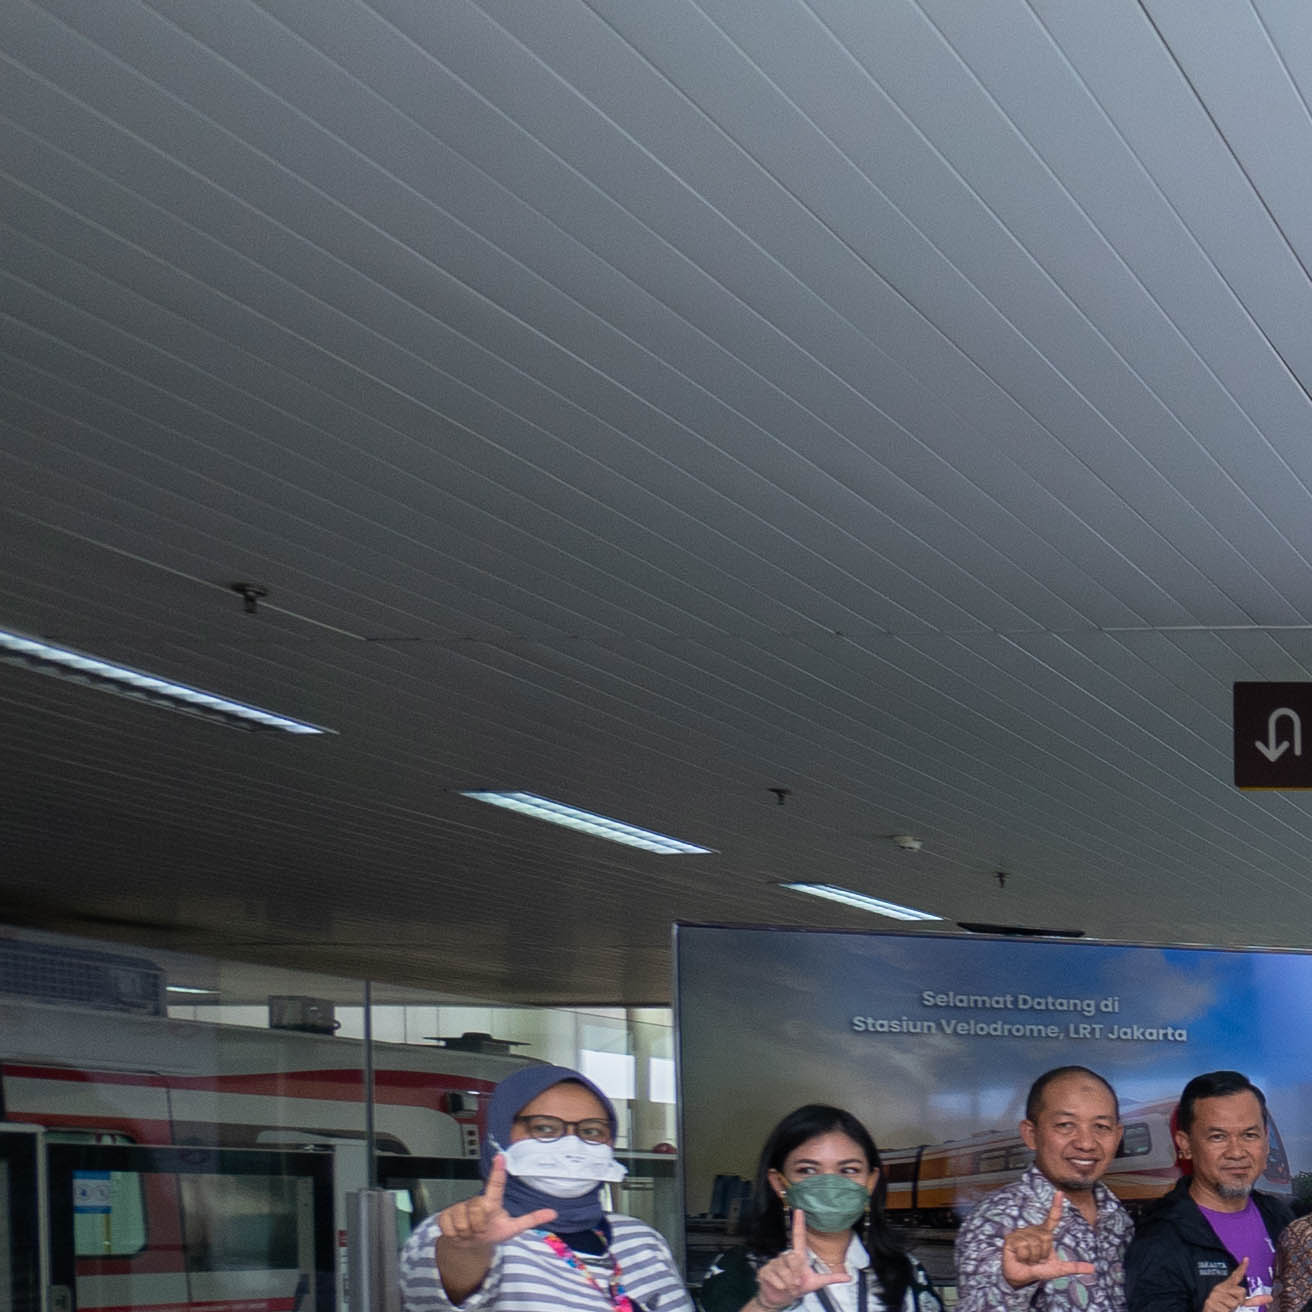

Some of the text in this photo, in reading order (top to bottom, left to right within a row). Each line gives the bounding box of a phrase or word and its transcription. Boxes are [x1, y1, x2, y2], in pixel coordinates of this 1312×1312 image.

[922, 990, 1119, 1016] Selamat Datang di
[852, 1016, 1188, 1042] Stasiun Velodrome, LRT Jakarta
